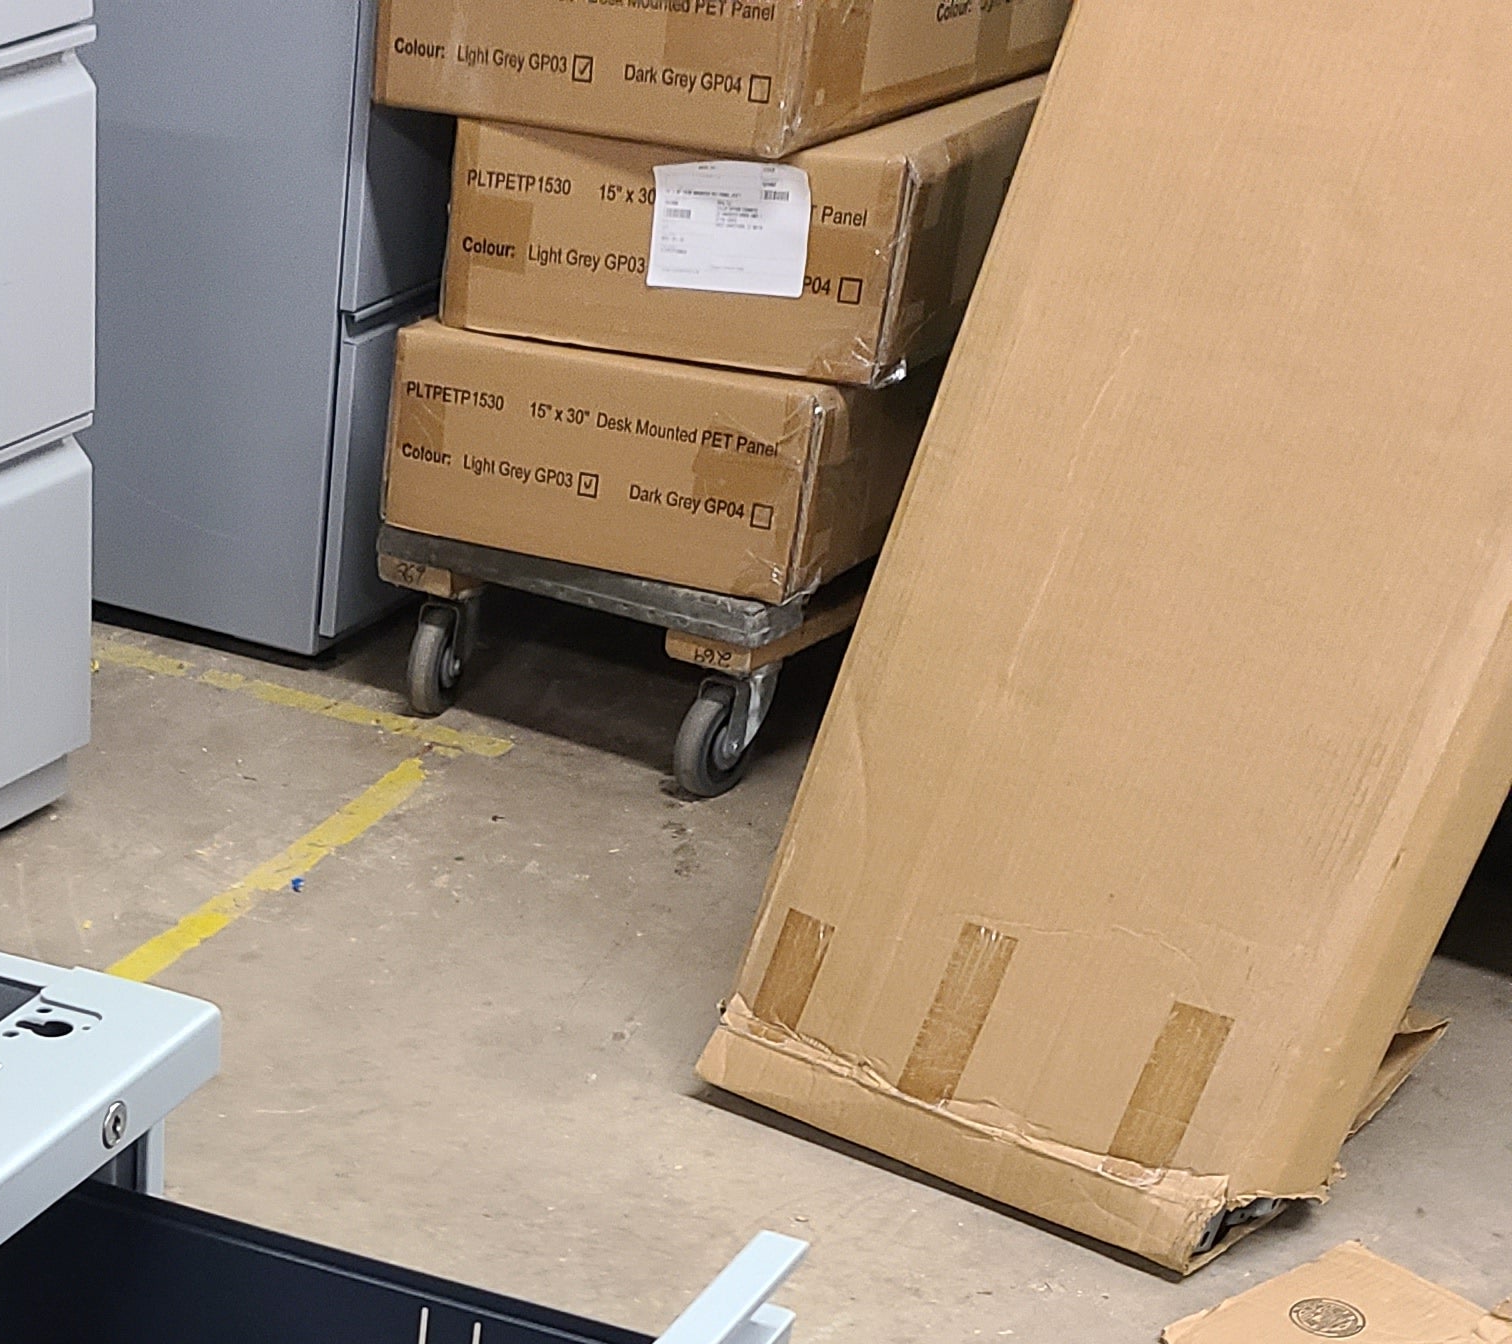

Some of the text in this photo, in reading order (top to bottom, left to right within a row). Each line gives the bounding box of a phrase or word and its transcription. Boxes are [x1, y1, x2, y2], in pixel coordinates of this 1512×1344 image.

[694, 0, 724, 16] PET
[731, 3, 775, 21] Panel
[394, 37, 567, 73] Colour: Light Grey GP03
[624, 64, 742, 93] Dark Grey GP04
[467, 169, 572, 196] PLTPETP1530
[599, 184, 623, 201] 15"
[625, 190, 634, 203] x
[638, 188, 656, 204] 30
[821, 206, 868, 227] Panel
[462, 236, 645, 274] Colour: Light Grey GP03
[804, 276, 831, 295] P04
[406, 381, 779, 457] PLTPETP1530 15" x 30" Desk Mounted PET Panel
[402, 443, 574, 488] Colour: Light Grey GP03
[629, 484, 745, 519] Dark Grey GP04
